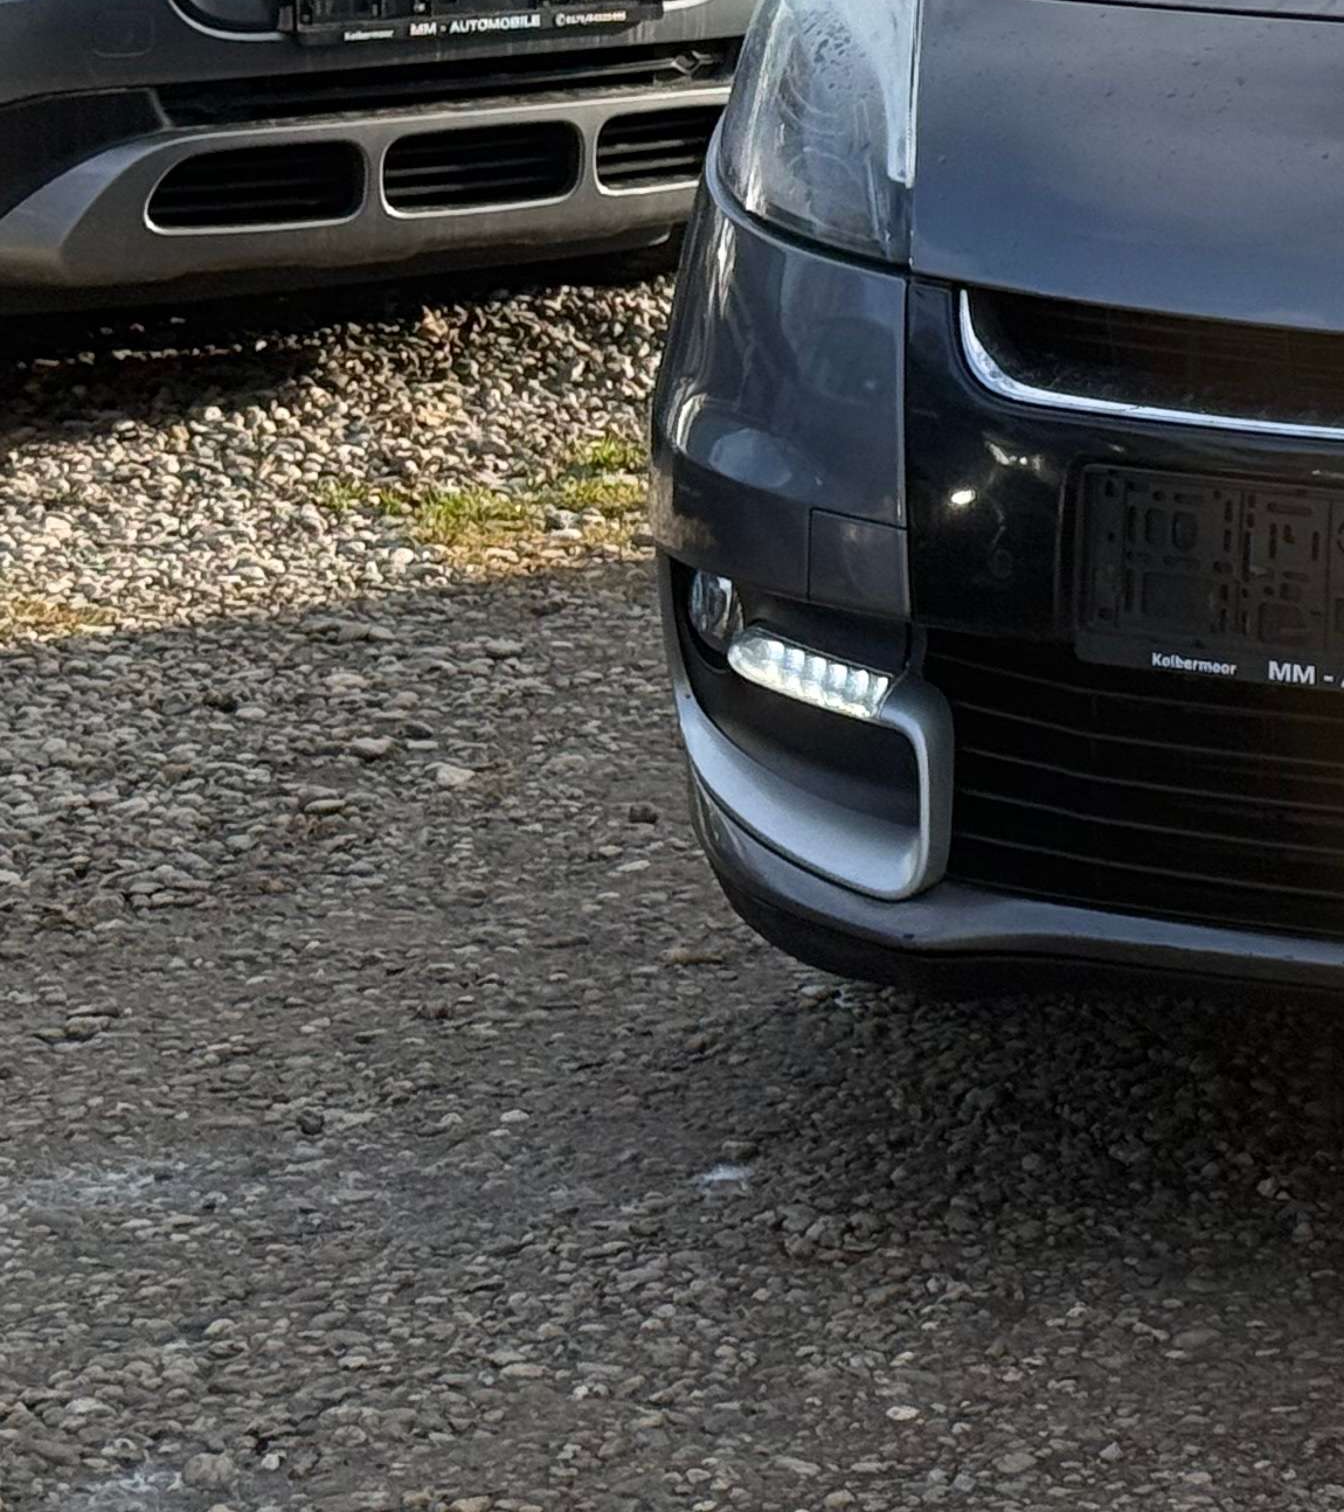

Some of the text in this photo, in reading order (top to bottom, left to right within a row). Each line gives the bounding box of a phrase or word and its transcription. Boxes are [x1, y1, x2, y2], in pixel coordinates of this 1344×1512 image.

[449, 14, 541, 34] AUTOMOBILE
[1151, 652, 1238, 676] Kolbermoor
[1268, 660, 1316, 686] MM
